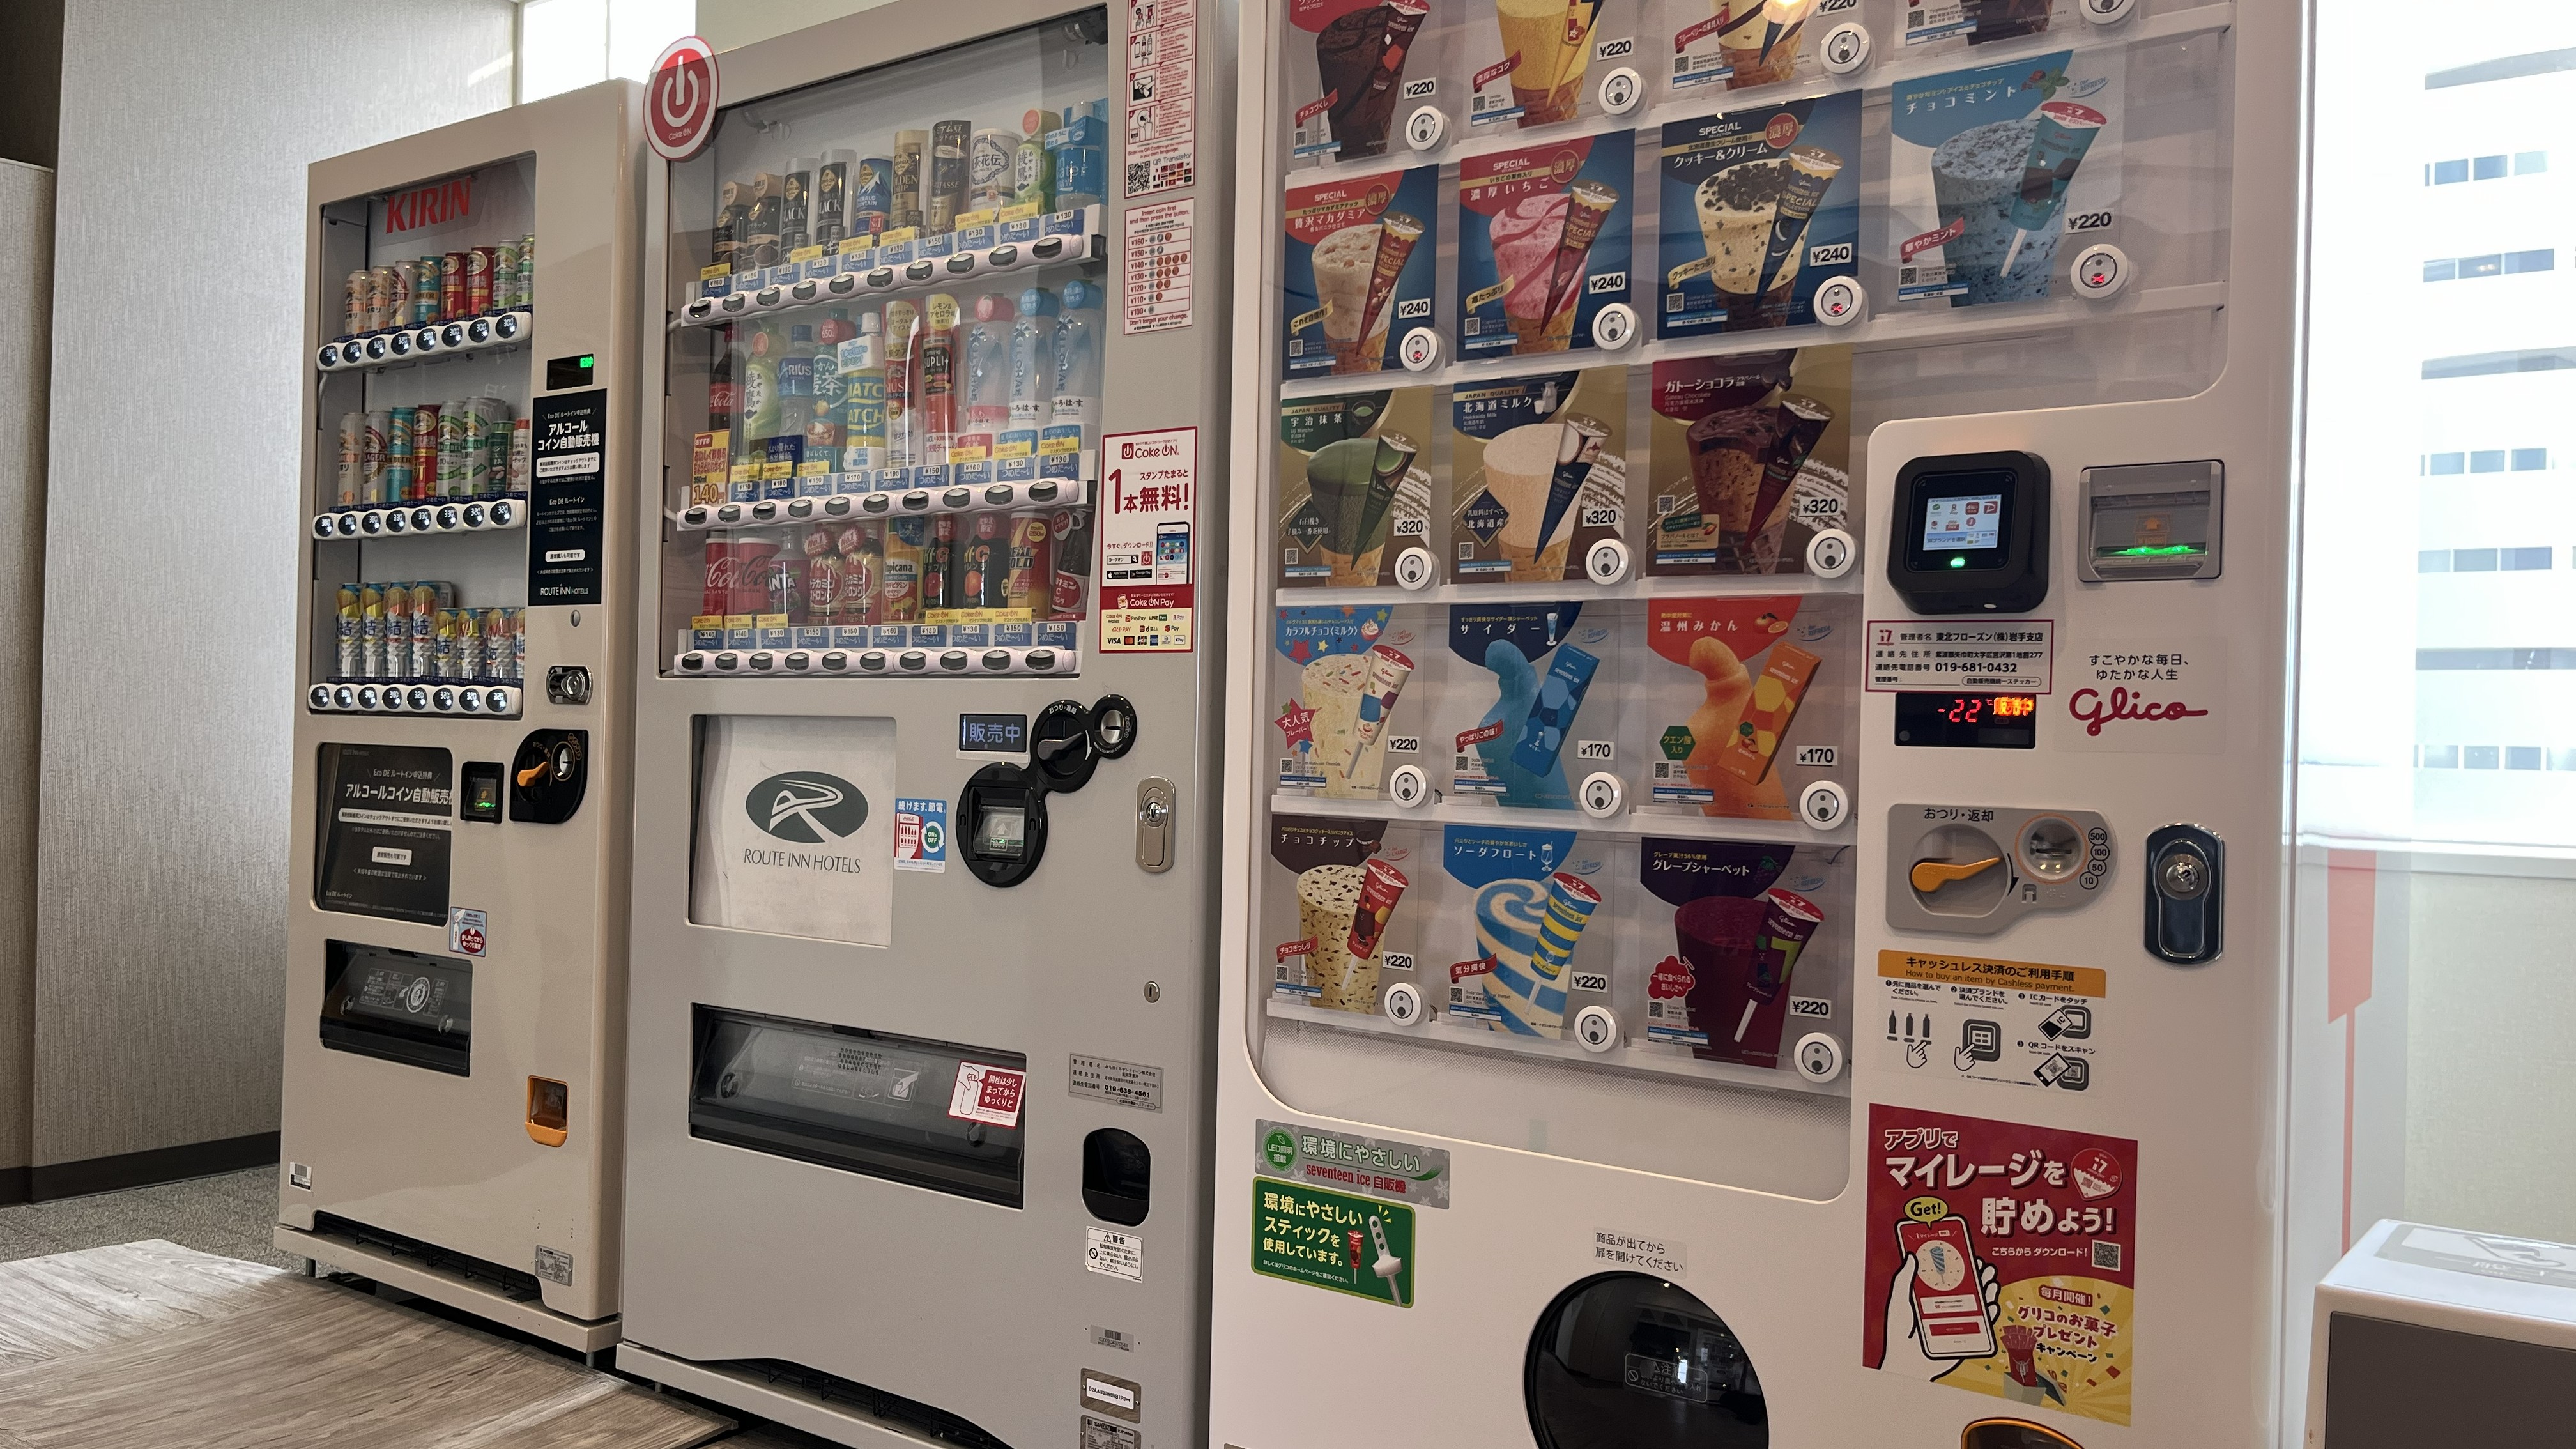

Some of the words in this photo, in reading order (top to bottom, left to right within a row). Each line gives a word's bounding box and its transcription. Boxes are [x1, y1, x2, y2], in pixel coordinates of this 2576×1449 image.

[1600, 40, 1632, 57] ¥220
[1406, 80, 1434, 96] ¥220
[1906, 86, 2016, 115] チョコミント
[1300, 100, 1328, 118] チョコづくし
[1699, 122, 1742, 137] SPECIAL
[1769, 122, 1795, 139] 濃厚
[1674, 143, 1768, 168] クッキー&クリーム
[1492, 158, 1530, 171] SPECIAL
[1314, 190, 1347, 202] SPECIAL
[386, 177, 471, 234] KIRIN
[1056, 211, 1071, 220] ¥130
[2068, 211, 2112, 229] ¥220
[968, 228, 983, 237] ¥130
[1011, 222, 1027, 230] ¥130
[1813, 247, 1849, 263] ¥240
[1591, 275, 1623, 291] ¥240
[1401, 302, 1428, 316] ¥240
[1490, 388, 1519, 397] QUALITY
[1664, 376, 1734, 394] ガトーショコラ
[1463, 397, 1533, 413] 北海道ミルク
[1291, 413, 1342, 427] 宇治抹茶
[549, 420, 588, 436] アルコール
[538, 432, 600, 451] コイン自動販売機
[1135, 447, 1160, 459] Coke
[1162, 443, 1178, 456] ON
[1050, 456, 1066, 464] ¥130
[1140, 468, 1189, 480] スタンプたまると
[1803, 499, 1838, 514] ¥320
[1586, 510, 1616, 524] ¥320
[1397, 520, 1423, 533] ¥320
[1130, 599, 1148, 607] Coke
[1160, 597, 1174, 608] Pay
[1460, 624, 1540, 634] サイダー
[1660, 620, 1738, 632] 温州みかん
[1935, 662, 2018, 673] 019-681-0432
[2089, 653, 2190, 667] すこやかな毎日、
[2096, 668, 2178, 681] ゆたかな人生
[2069, 686, 2209, 737] Glico
[1282, 712, 1310, 729] 大人気
[969, 723, 1020, 743] 販売中
[1663, 735, 1692, 745] クエン酸
[1390, 739, 1418, 751] ¥220
[1581, 744, 1611, 757] ¥170
[1671, 746, 1683, 754] 入り
[1800, 748, 1834, 763] ¥170
[1924, 808, 1994, 822] おつり・返却
[1280, 834, 1354, 848] チョコチップ
[2090, 832, 2106, 841] 500
[1453, 846, 1537, 861] ソーダフロート
[2093, 848, 2107, 857] 100
[744, 848, 785, 866] ROUTE
[788, 853, 811, 868] INN
[814, 854, 861, 874] HOTELS
[1652, 859, 1750, 877] グレープシャーベット
[2091, 863, 2103, 872] 50
[2084, 877, 2094, 885] 10
[1280, 942, 1310, 954] チョコぎっしり
[1384, 955, 1412, 968] ¥220
[1455, 962, 1487, 975] 気分爽快
[1906, 956, 2074, 982] キャッシュレス決済のご利用手順
[1574, 976, 1606, 990] ¥220
[1905, 969, 1923, 978] How
[1935, 972, 1951, 982] buy
[1965, 975, 1983, 983] item
[1985, 976, 1995, 986] by
[1997, 977, 2033, 988] Cashless
[2035, 982, 2075, 992] payment.
[1959, 993, 2009, 1004] 選んでください。
[1792, 1000, 1829, 1016] ¥220
[2040, 1043, 2096, 1054] コードをスキャン
[986, 1085, 1015, 1098] まってから
[984, 1096, 1013, 1108] ゆっくりと
[1884, 1127, 1959, 1150] アプリで
[1301, 1135, 1421, 1172] 環境にやさしい
[1884, 1149, 2067, 1188] マイレージを
[1306, 1163, 1354, 1183] seventeen
[1356, 1169, 1371, 1186] ice
[1374, 1175, 1407, 1193] 自販機
[1263, 1192, 1363, 1226] 環境にやさしい
[1910, 1202, 1942, 1216] Get!
[1981, 1197, 2114, 1236] 貯めよう!
[1263, 1216, 1340, 1248] スティックを
[1596, 1232, 1666, 1255] 商品が出てから
[1262, 1237, 1344, 1267] 使用しています。
[1595, 1246, 1683, 1273] 扉を開けてください
[1992, 1247, 2032, 1257] こちらから
[2034, 1248, 2087, 1257] ダウンロード!
[2040, 1286, 2092, 1306] 毎月開催!
[2018, 1305, 2117, 1335] グリコのお菓子
[2033, 1325, 2098, 1348] プレゼント
[2035, 1342, 2097, 1363] キャンペーン
